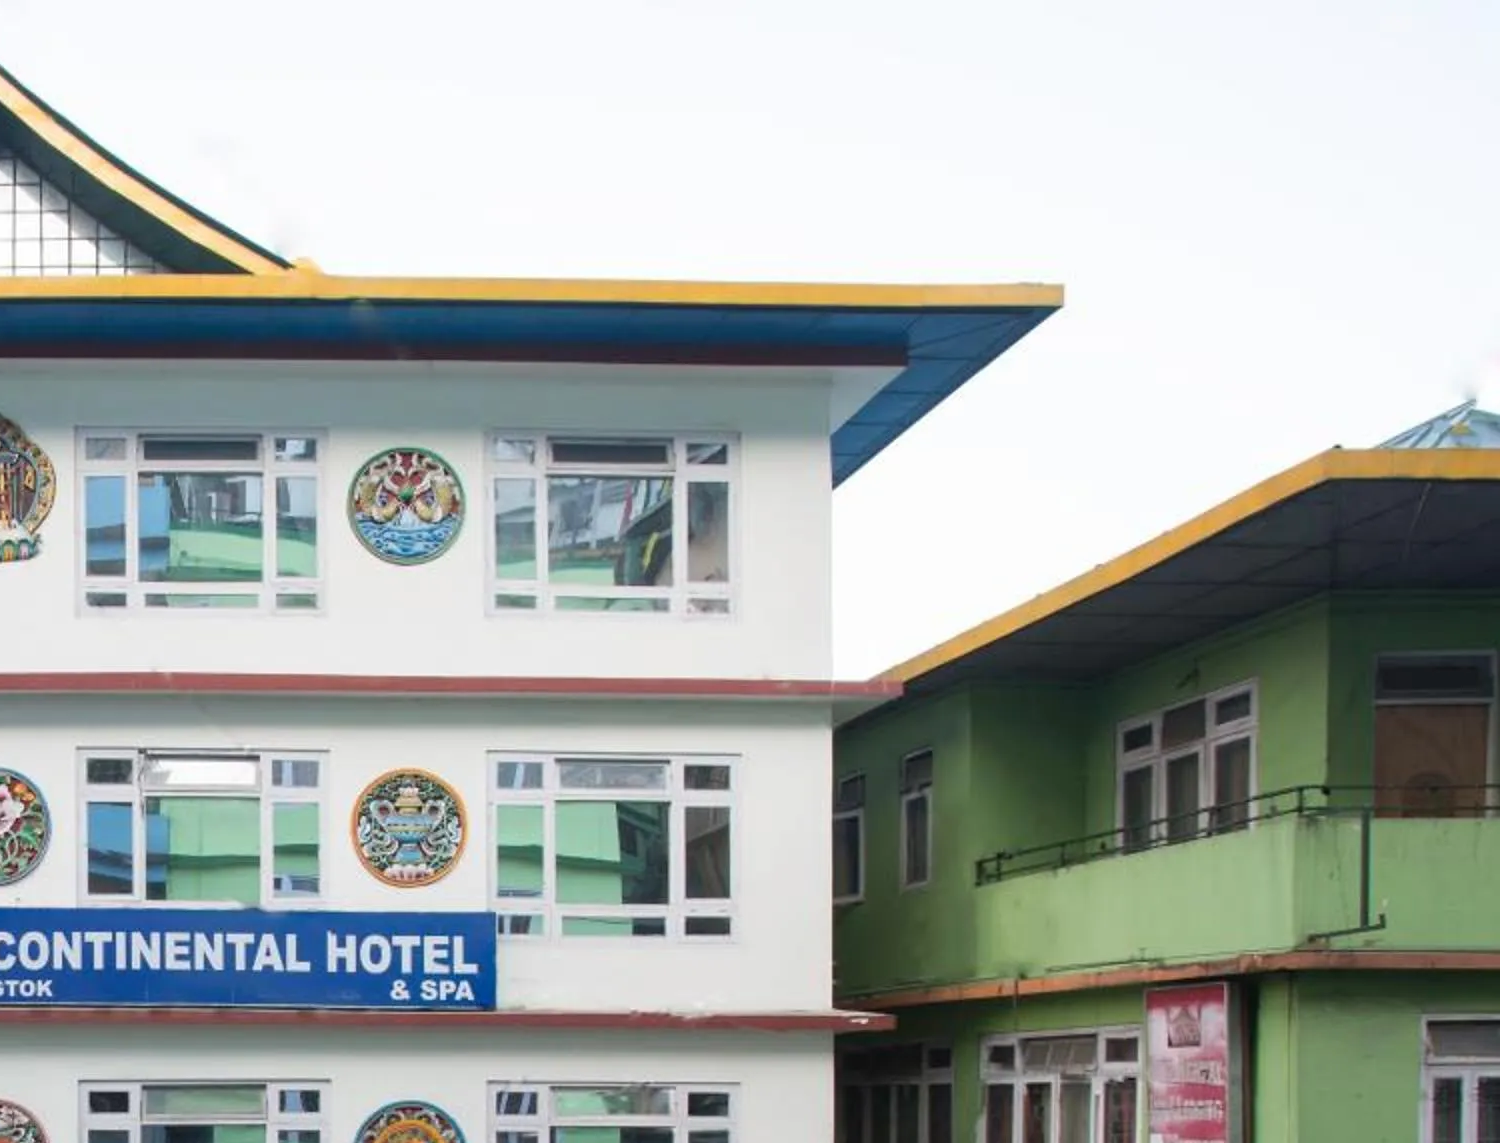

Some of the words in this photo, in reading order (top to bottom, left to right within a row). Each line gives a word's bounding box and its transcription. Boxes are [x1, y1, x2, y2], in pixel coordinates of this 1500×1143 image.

[327, 930, 479, 975] HOTEL
[390, 980, 410, 1001] &
[420, 980, 475, 1001] SPA
